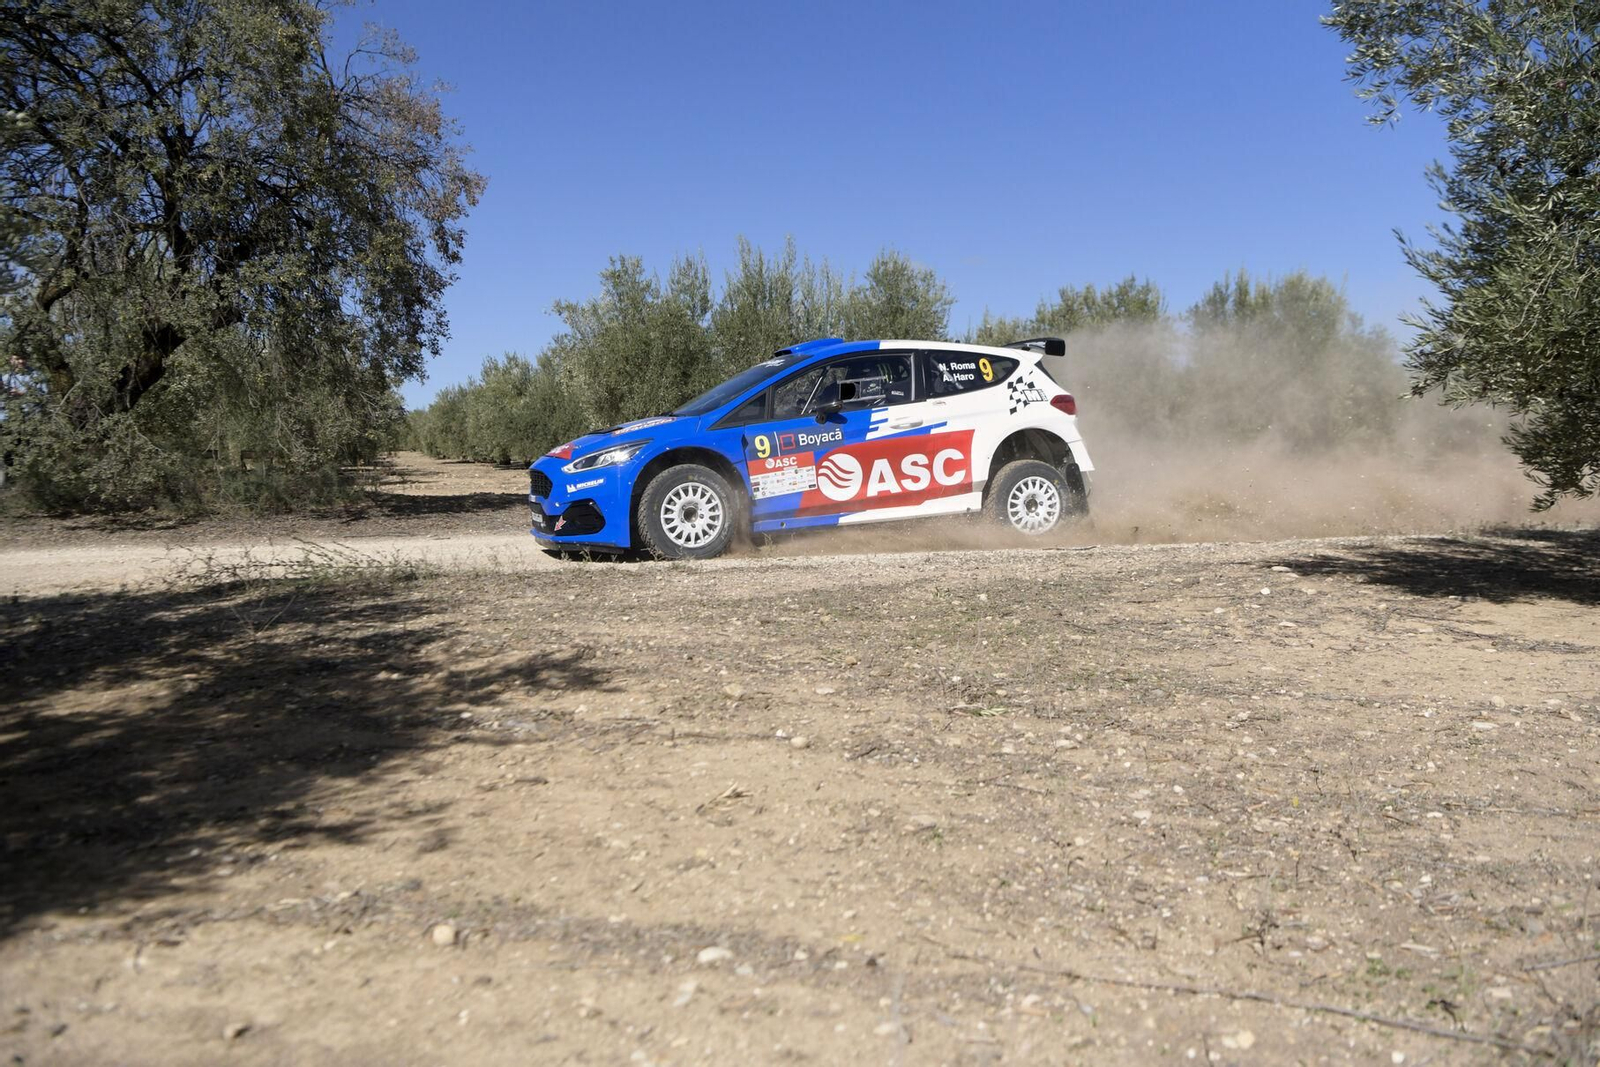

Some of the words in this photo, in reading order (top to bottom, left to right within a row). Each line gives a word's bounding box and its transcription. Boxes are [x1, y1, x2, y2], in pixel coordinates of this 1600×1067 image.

[938, 363, 949, 371] N.
[950, 362, 976, 371] Roma
[978, 358, 993, 382] 9
[953, 373, 975, 382] Haro
[754, 435, 771, 459] 9
[775, 456, 798, 468] ASC
[866, 448, 967, 497] ASC
